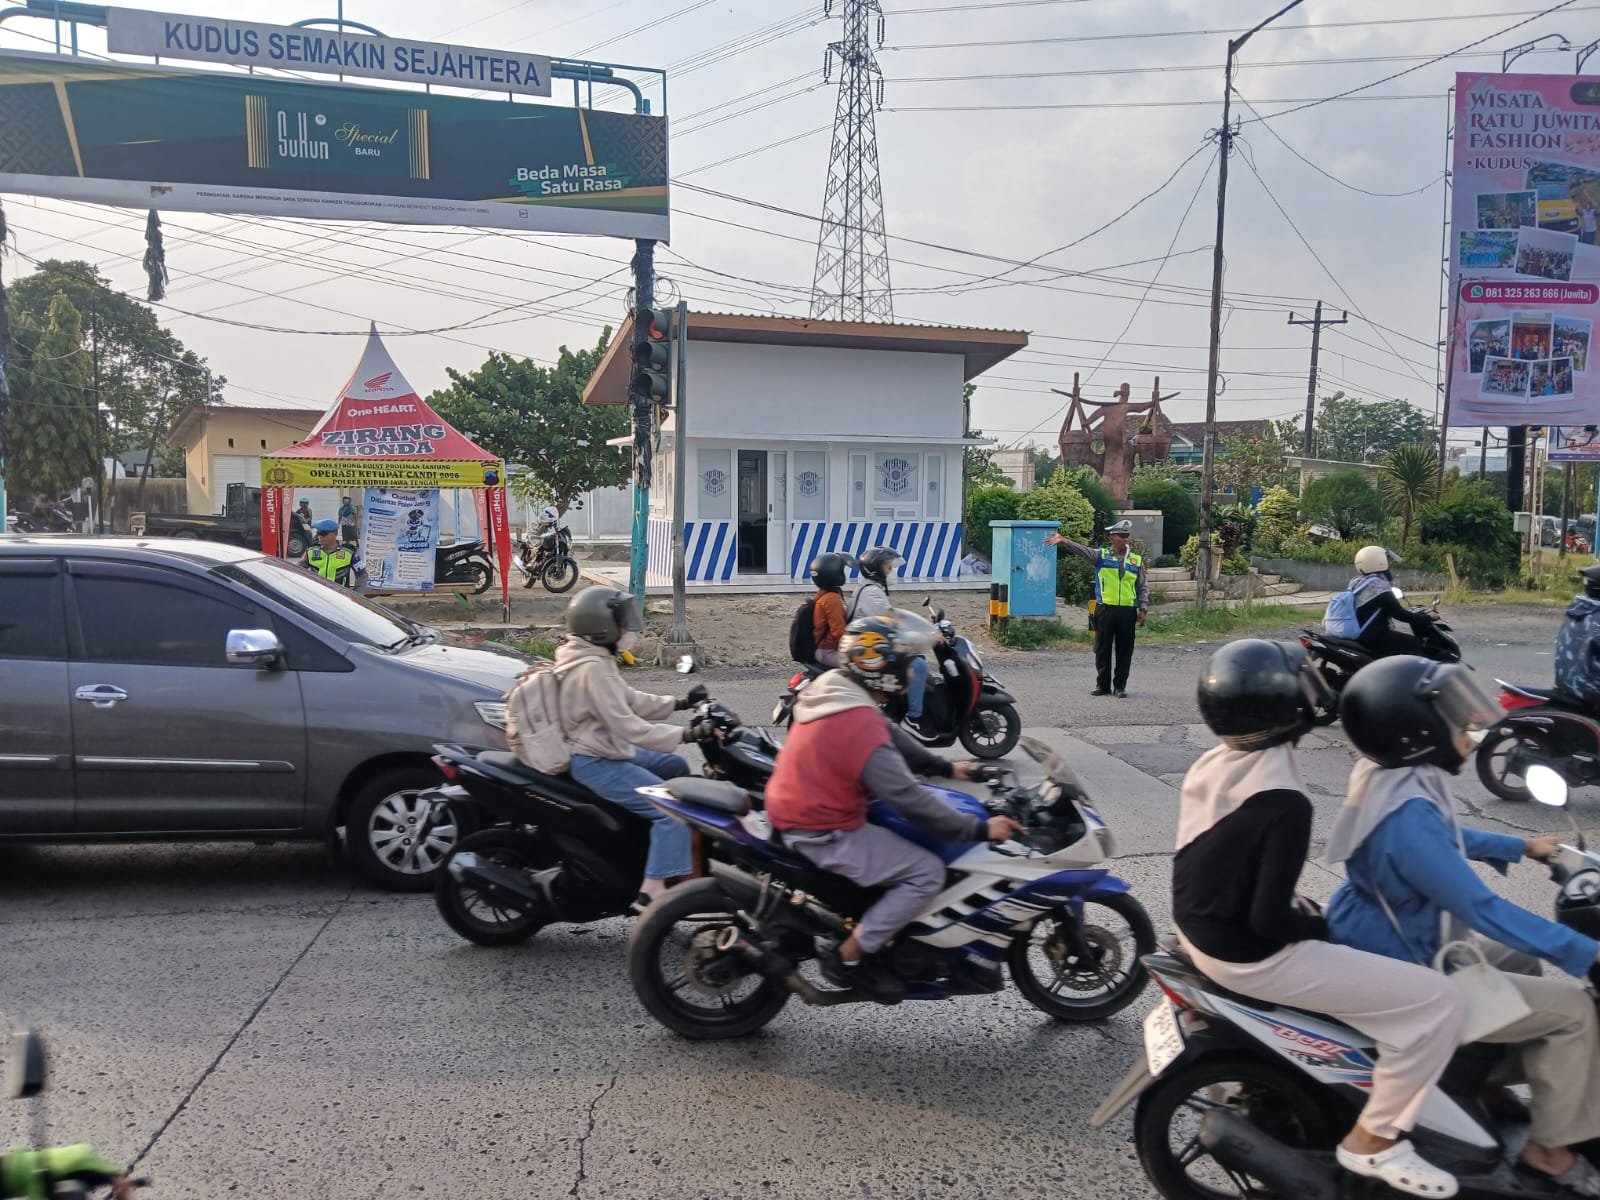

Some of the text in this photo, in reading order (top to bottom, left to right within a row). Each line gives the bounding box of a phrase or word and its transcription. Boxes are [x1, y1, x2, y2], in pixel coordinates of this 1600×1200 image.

[165, 21, 541, 87] KUDUS SEMAKIN SEJAHTERA
[1471, 91, 1544, 110] WISATA
[1471, 110, 1600, 132] RATU JUWITA
[334, 122, 400, 146] Special
[1470, 133, 1561, 148] FASHION
[355, 147, 381, 157] BARU
[516, 163, 607, 181] Beda Masa
[541, 177, 622, 195] Satu Rasa
[1485, 288, 1592, 301] 081 325 263 666 (Juwita)
[347, 408, 373, 417] One
[322, 424, 446, 446] ZIRANG
[336, 440, 435, 456] HONDA
[310, 470, 460, 480] OPERASI KETUPAT CANDI 2026
